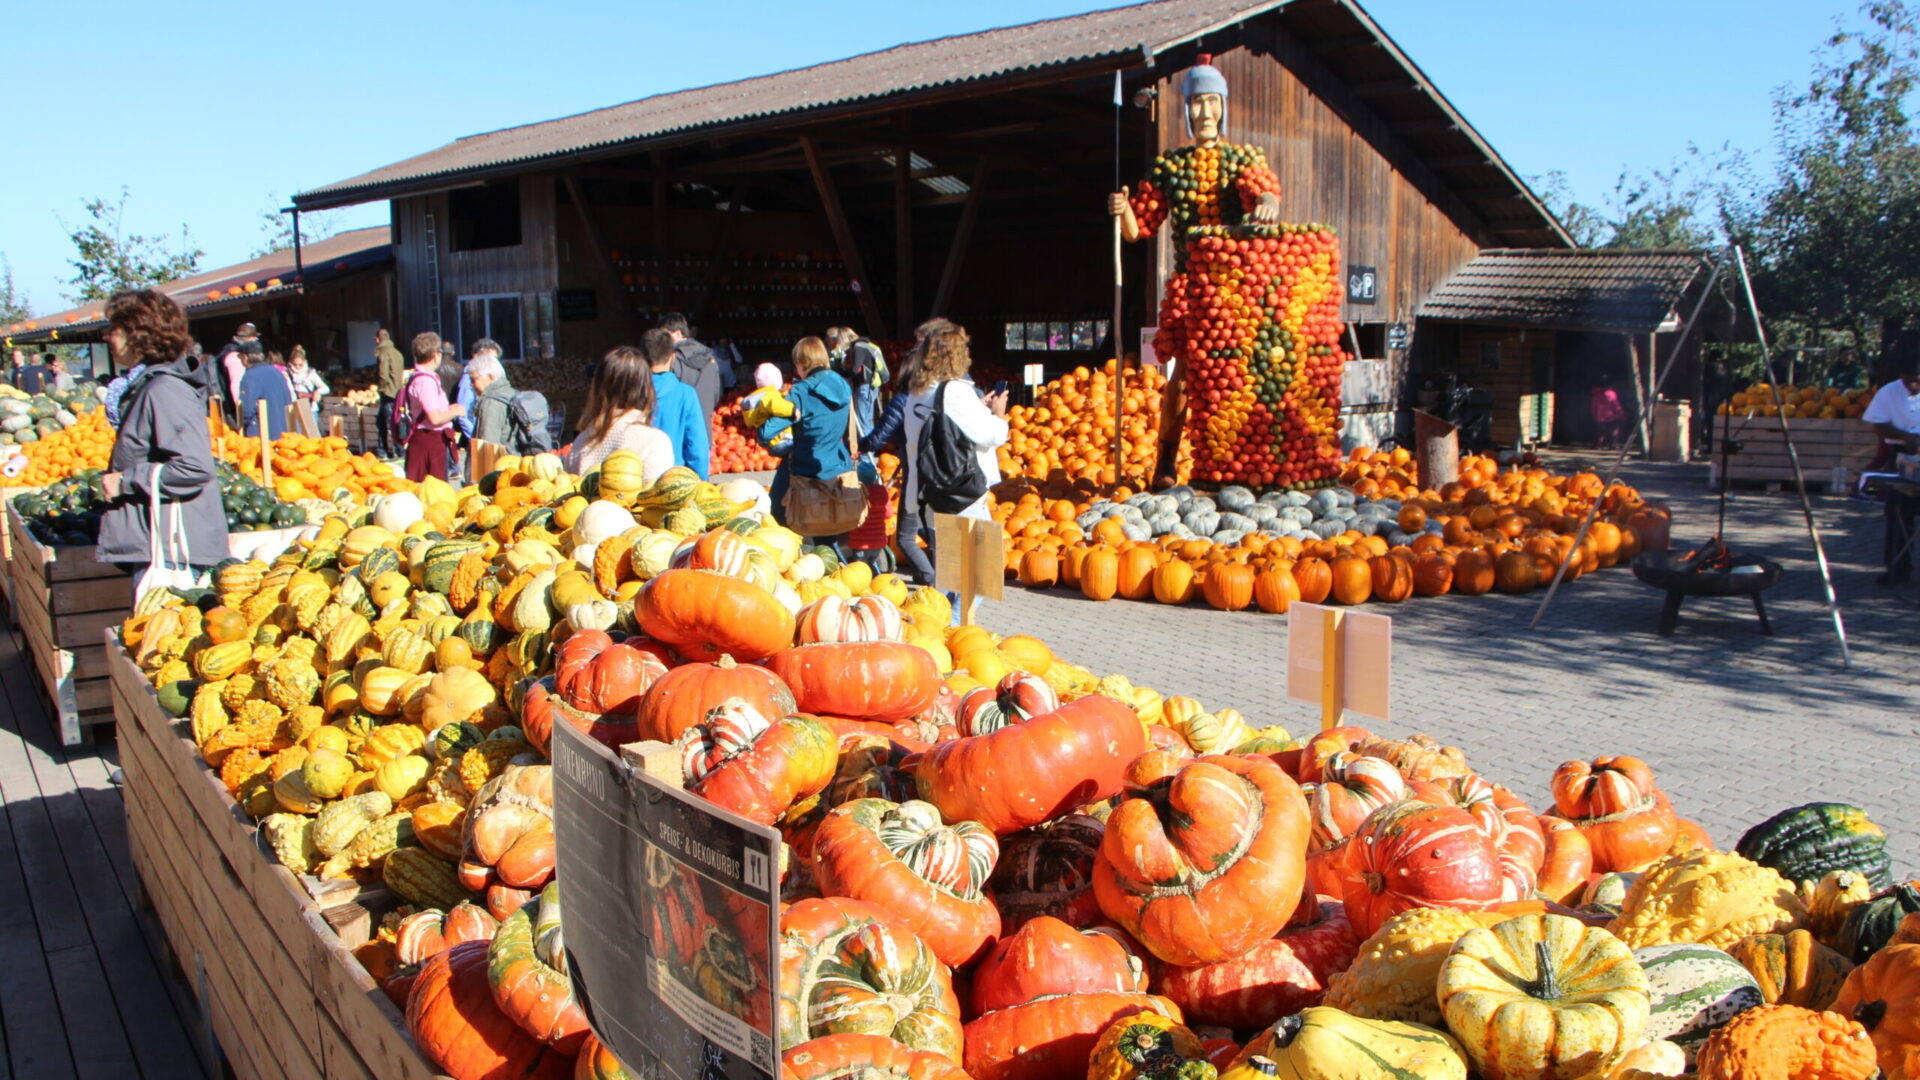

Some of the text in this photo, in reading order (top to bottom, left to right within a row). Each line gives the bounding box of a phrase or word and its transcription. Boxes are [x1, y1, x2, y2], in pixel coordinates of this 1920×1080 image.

[659, 821, 740, 880] SPEISE- & DEKOKÜRBIS
